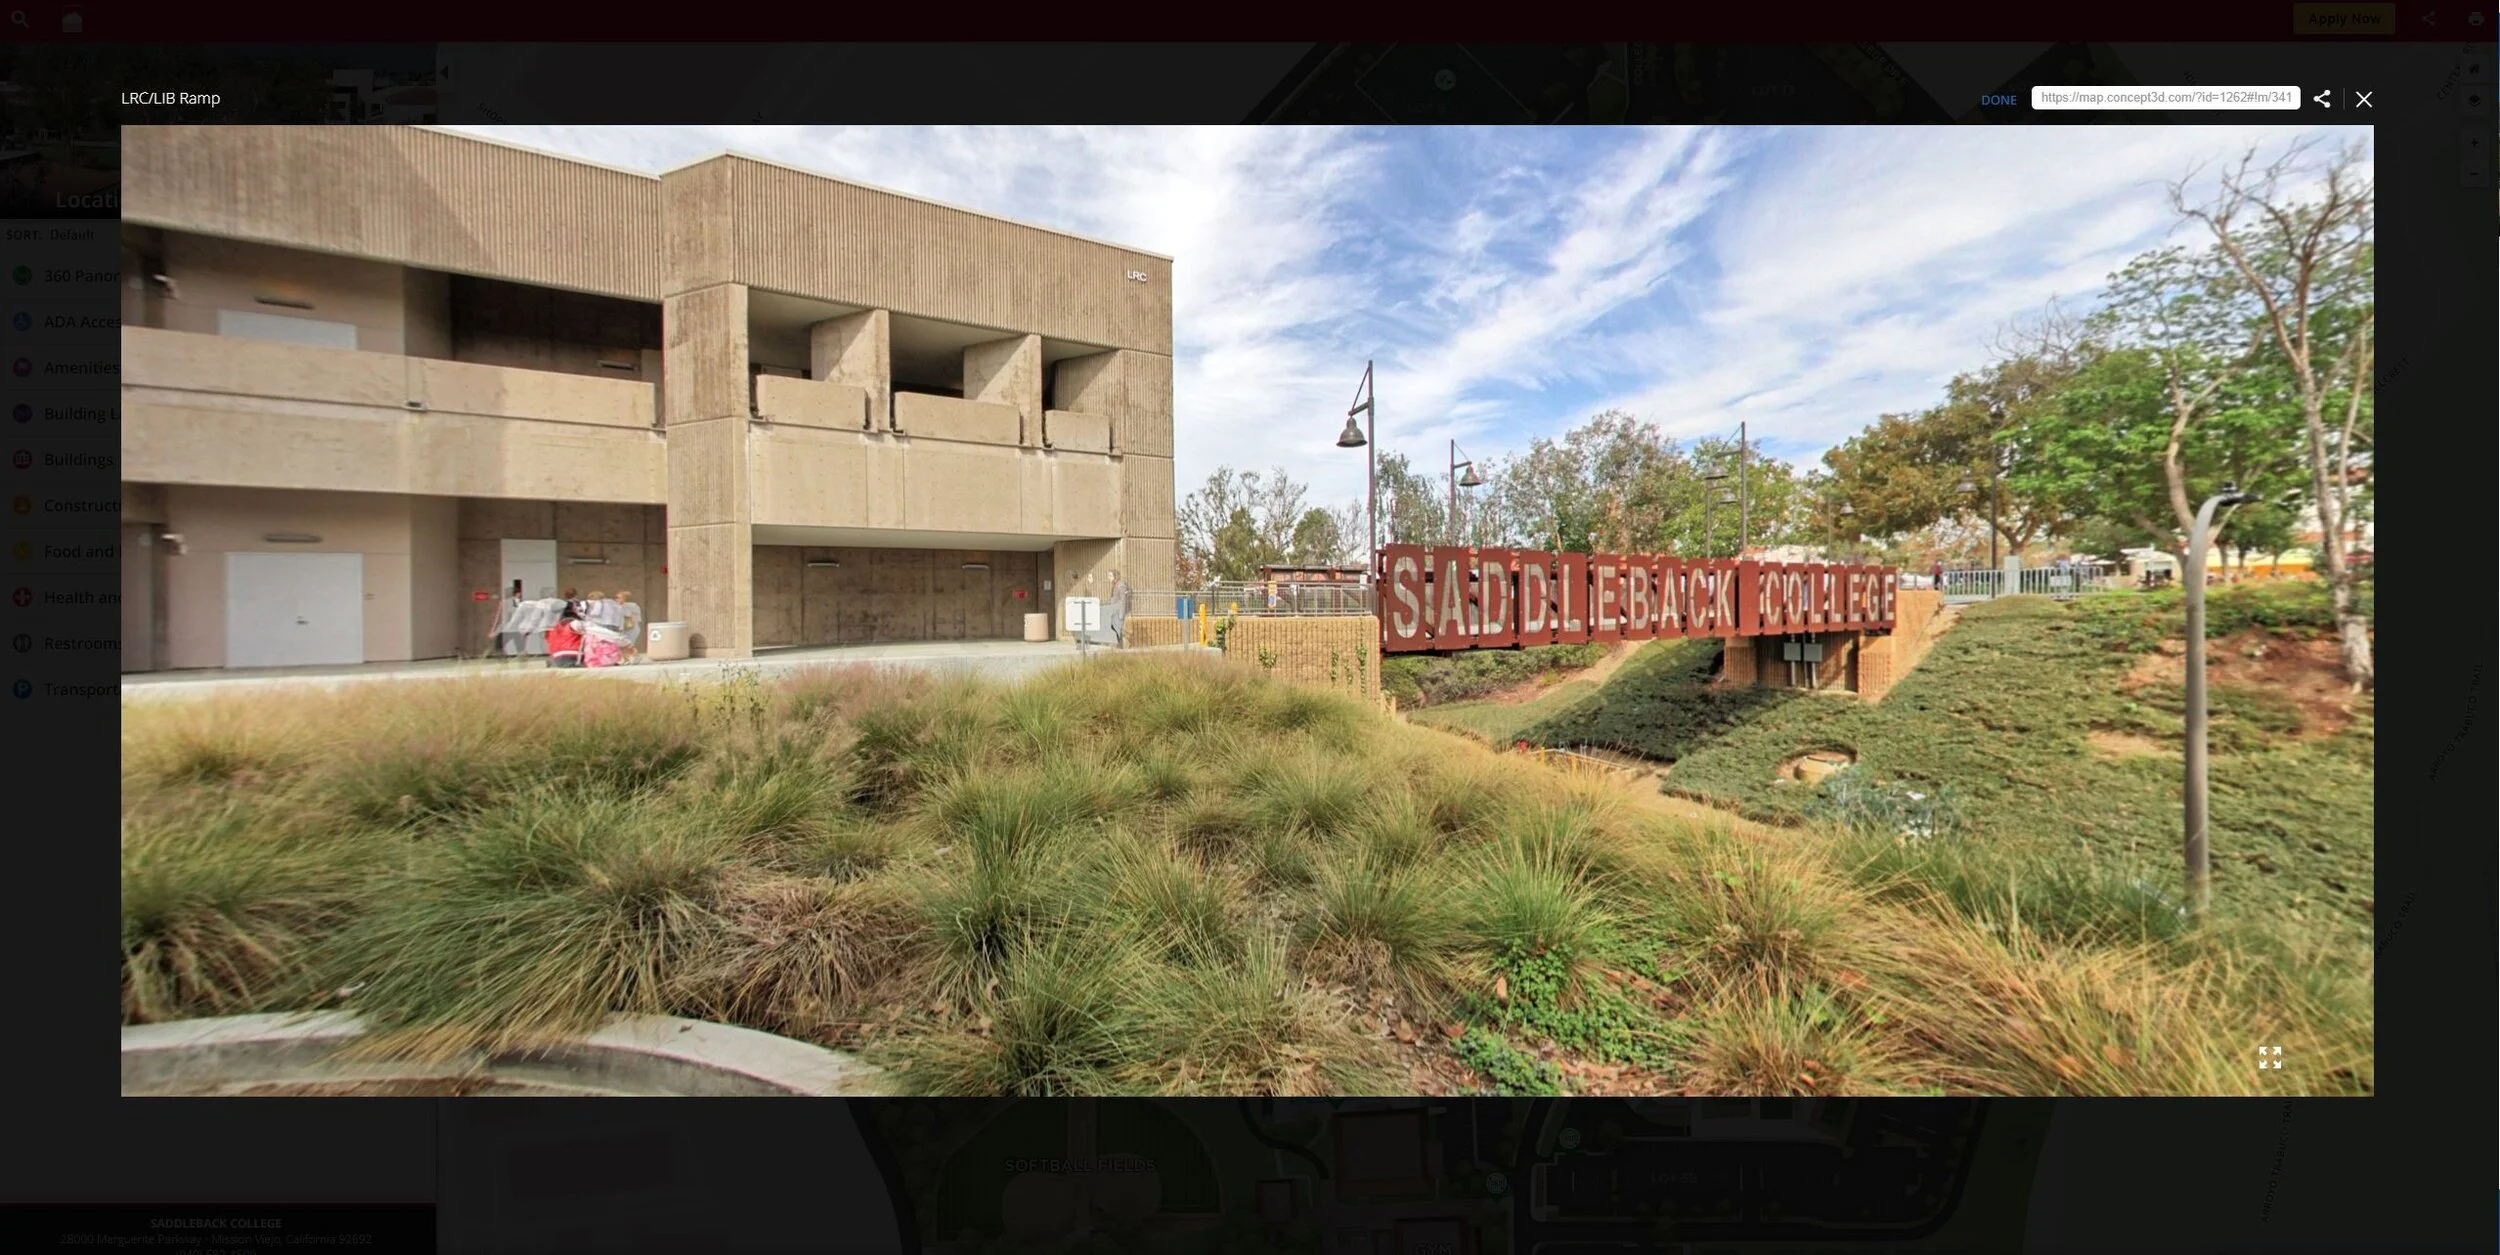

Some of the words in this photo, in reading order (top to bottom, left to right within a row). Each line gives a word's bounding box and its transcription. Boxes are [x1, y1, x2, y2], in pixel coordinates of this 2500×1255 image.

[1127, 270, 1147, 282] LRC
[1391, 554, 1736, 640] SADDLEBACK
[1763, 570, 1896, 624] COLLEGE
